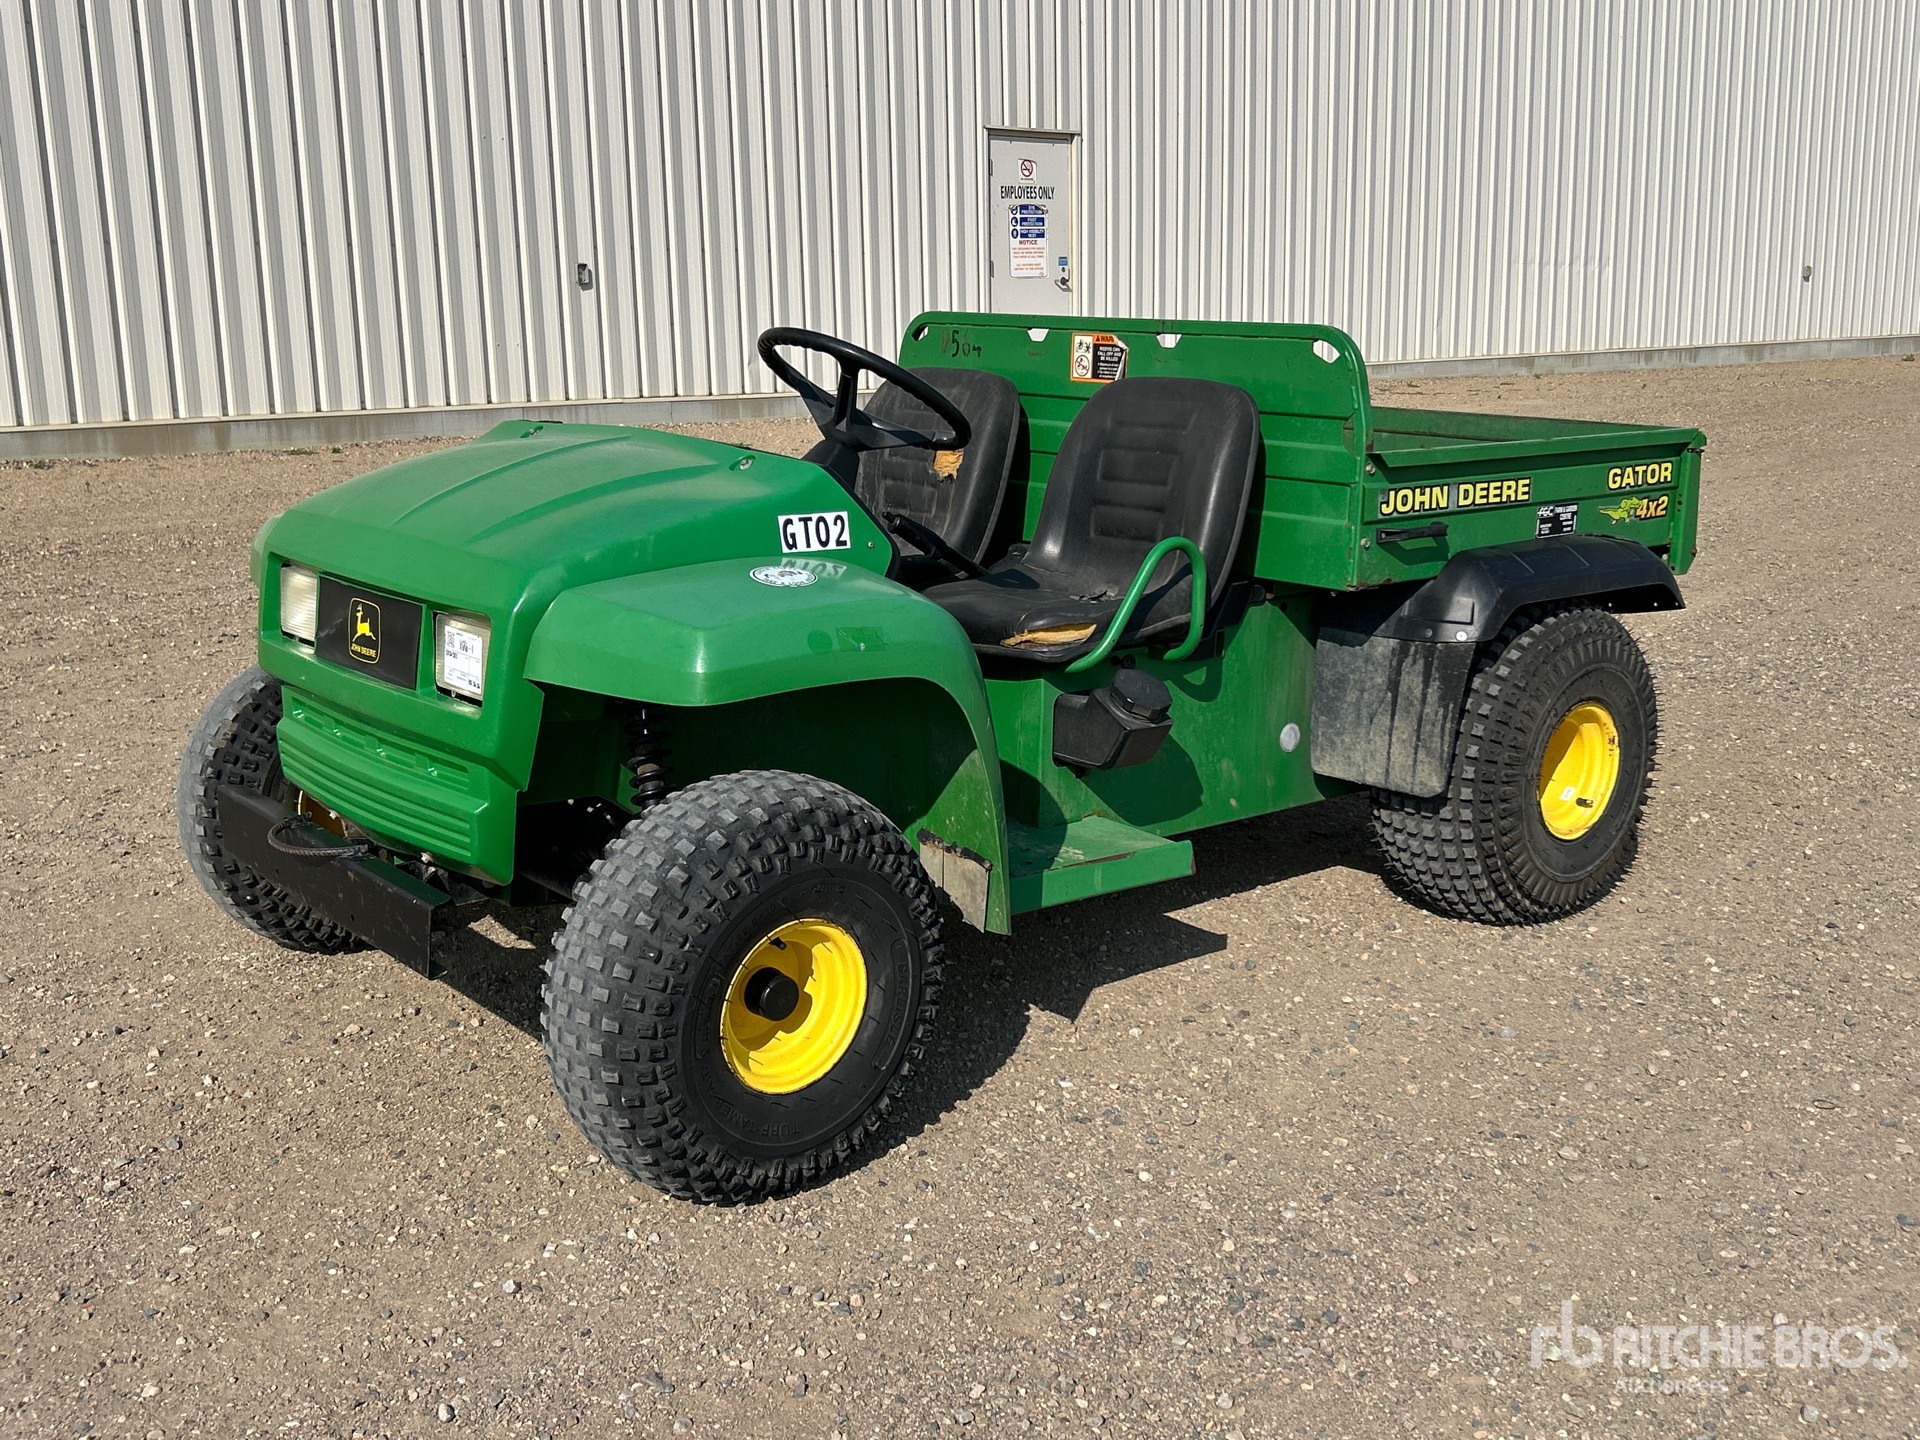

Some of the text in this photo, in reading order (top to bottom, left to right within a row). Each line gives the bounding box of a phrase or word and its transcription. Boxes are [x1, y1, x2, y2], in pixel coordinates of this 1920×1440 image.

[1000, 185, 1055, 200] EMPLOYEES ONLY
[1608, 461, 1673, 490] GATOR
[1380, 478, 1531, 516] JOHN DEERE
[1635, 495, 1669, 519] 4x2
[351, 643, 377, 658] JOHN DEERE
